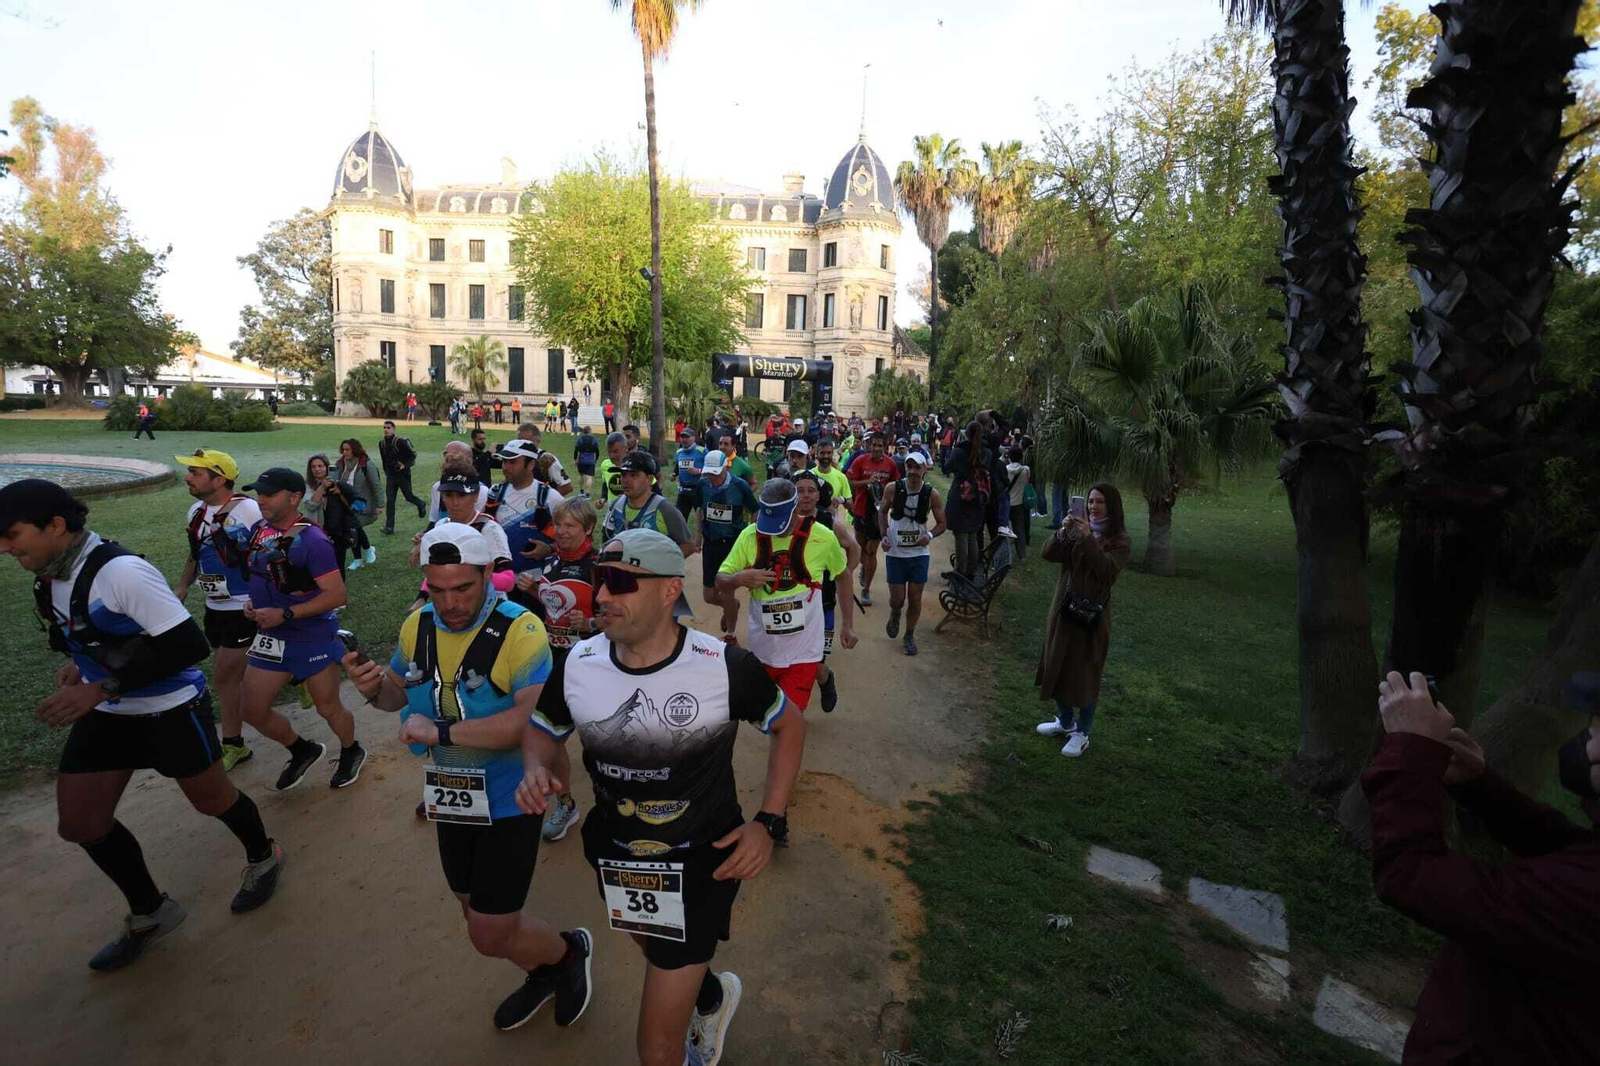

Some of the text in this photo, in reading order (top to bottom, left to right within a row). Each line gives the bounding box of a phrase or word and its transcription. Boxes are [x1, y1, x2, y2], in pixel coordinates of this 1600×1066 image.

[755, 358, 801, 376] Sherry
[712, 509, 724, 518] 47
[772, 612, 793, 625] 50
[259, 637, 274, 650] 65
[434, 788, 473, 808] 229
[622, 872, 658, 885] Sherry
[625, 889, 659, 914] 38
